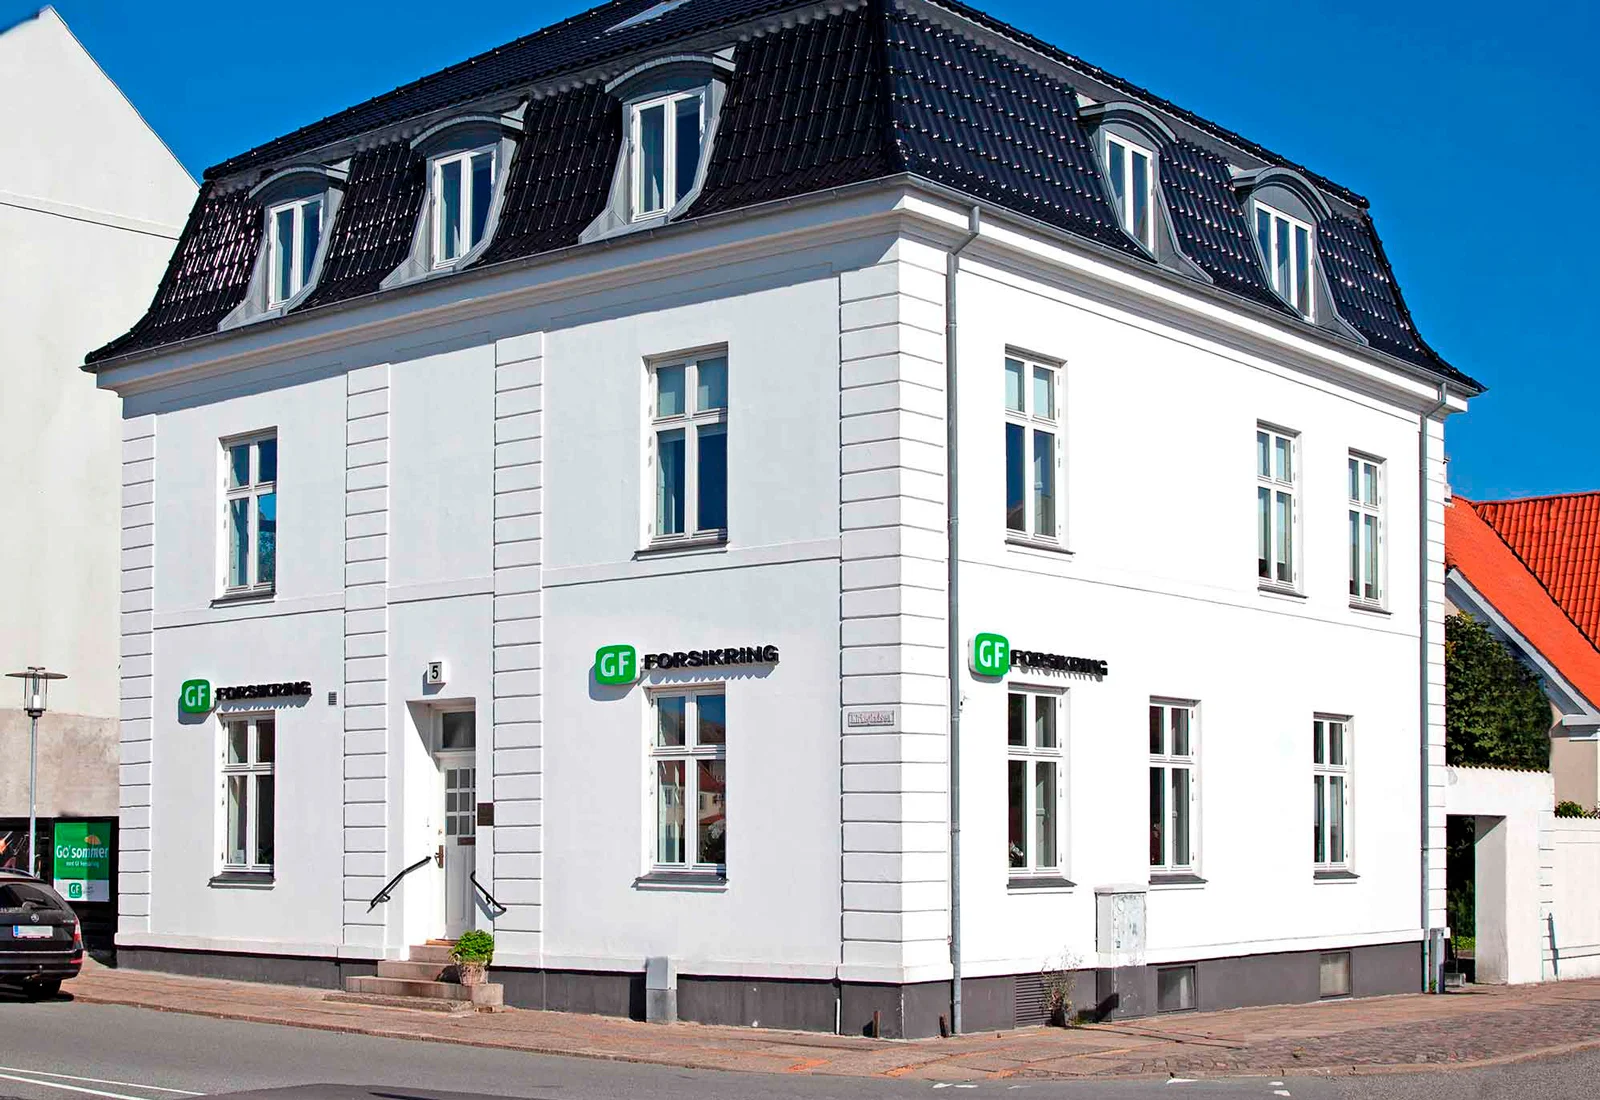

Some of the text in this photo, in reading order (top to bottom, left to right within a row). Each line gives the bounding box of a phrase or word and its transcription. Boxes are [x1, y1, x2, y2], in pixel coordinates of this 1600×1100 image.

[601, 645, 779, 678] GF FORSIKRING
[980, 640, 1108, 675] GF FORSIKRING
[431, 664, 439, 680] 5
[184, 681, 311, 707] GF FORSIKRING
[71, 847, 109, 859] sommer
[70, 884, 80, 894] GF
